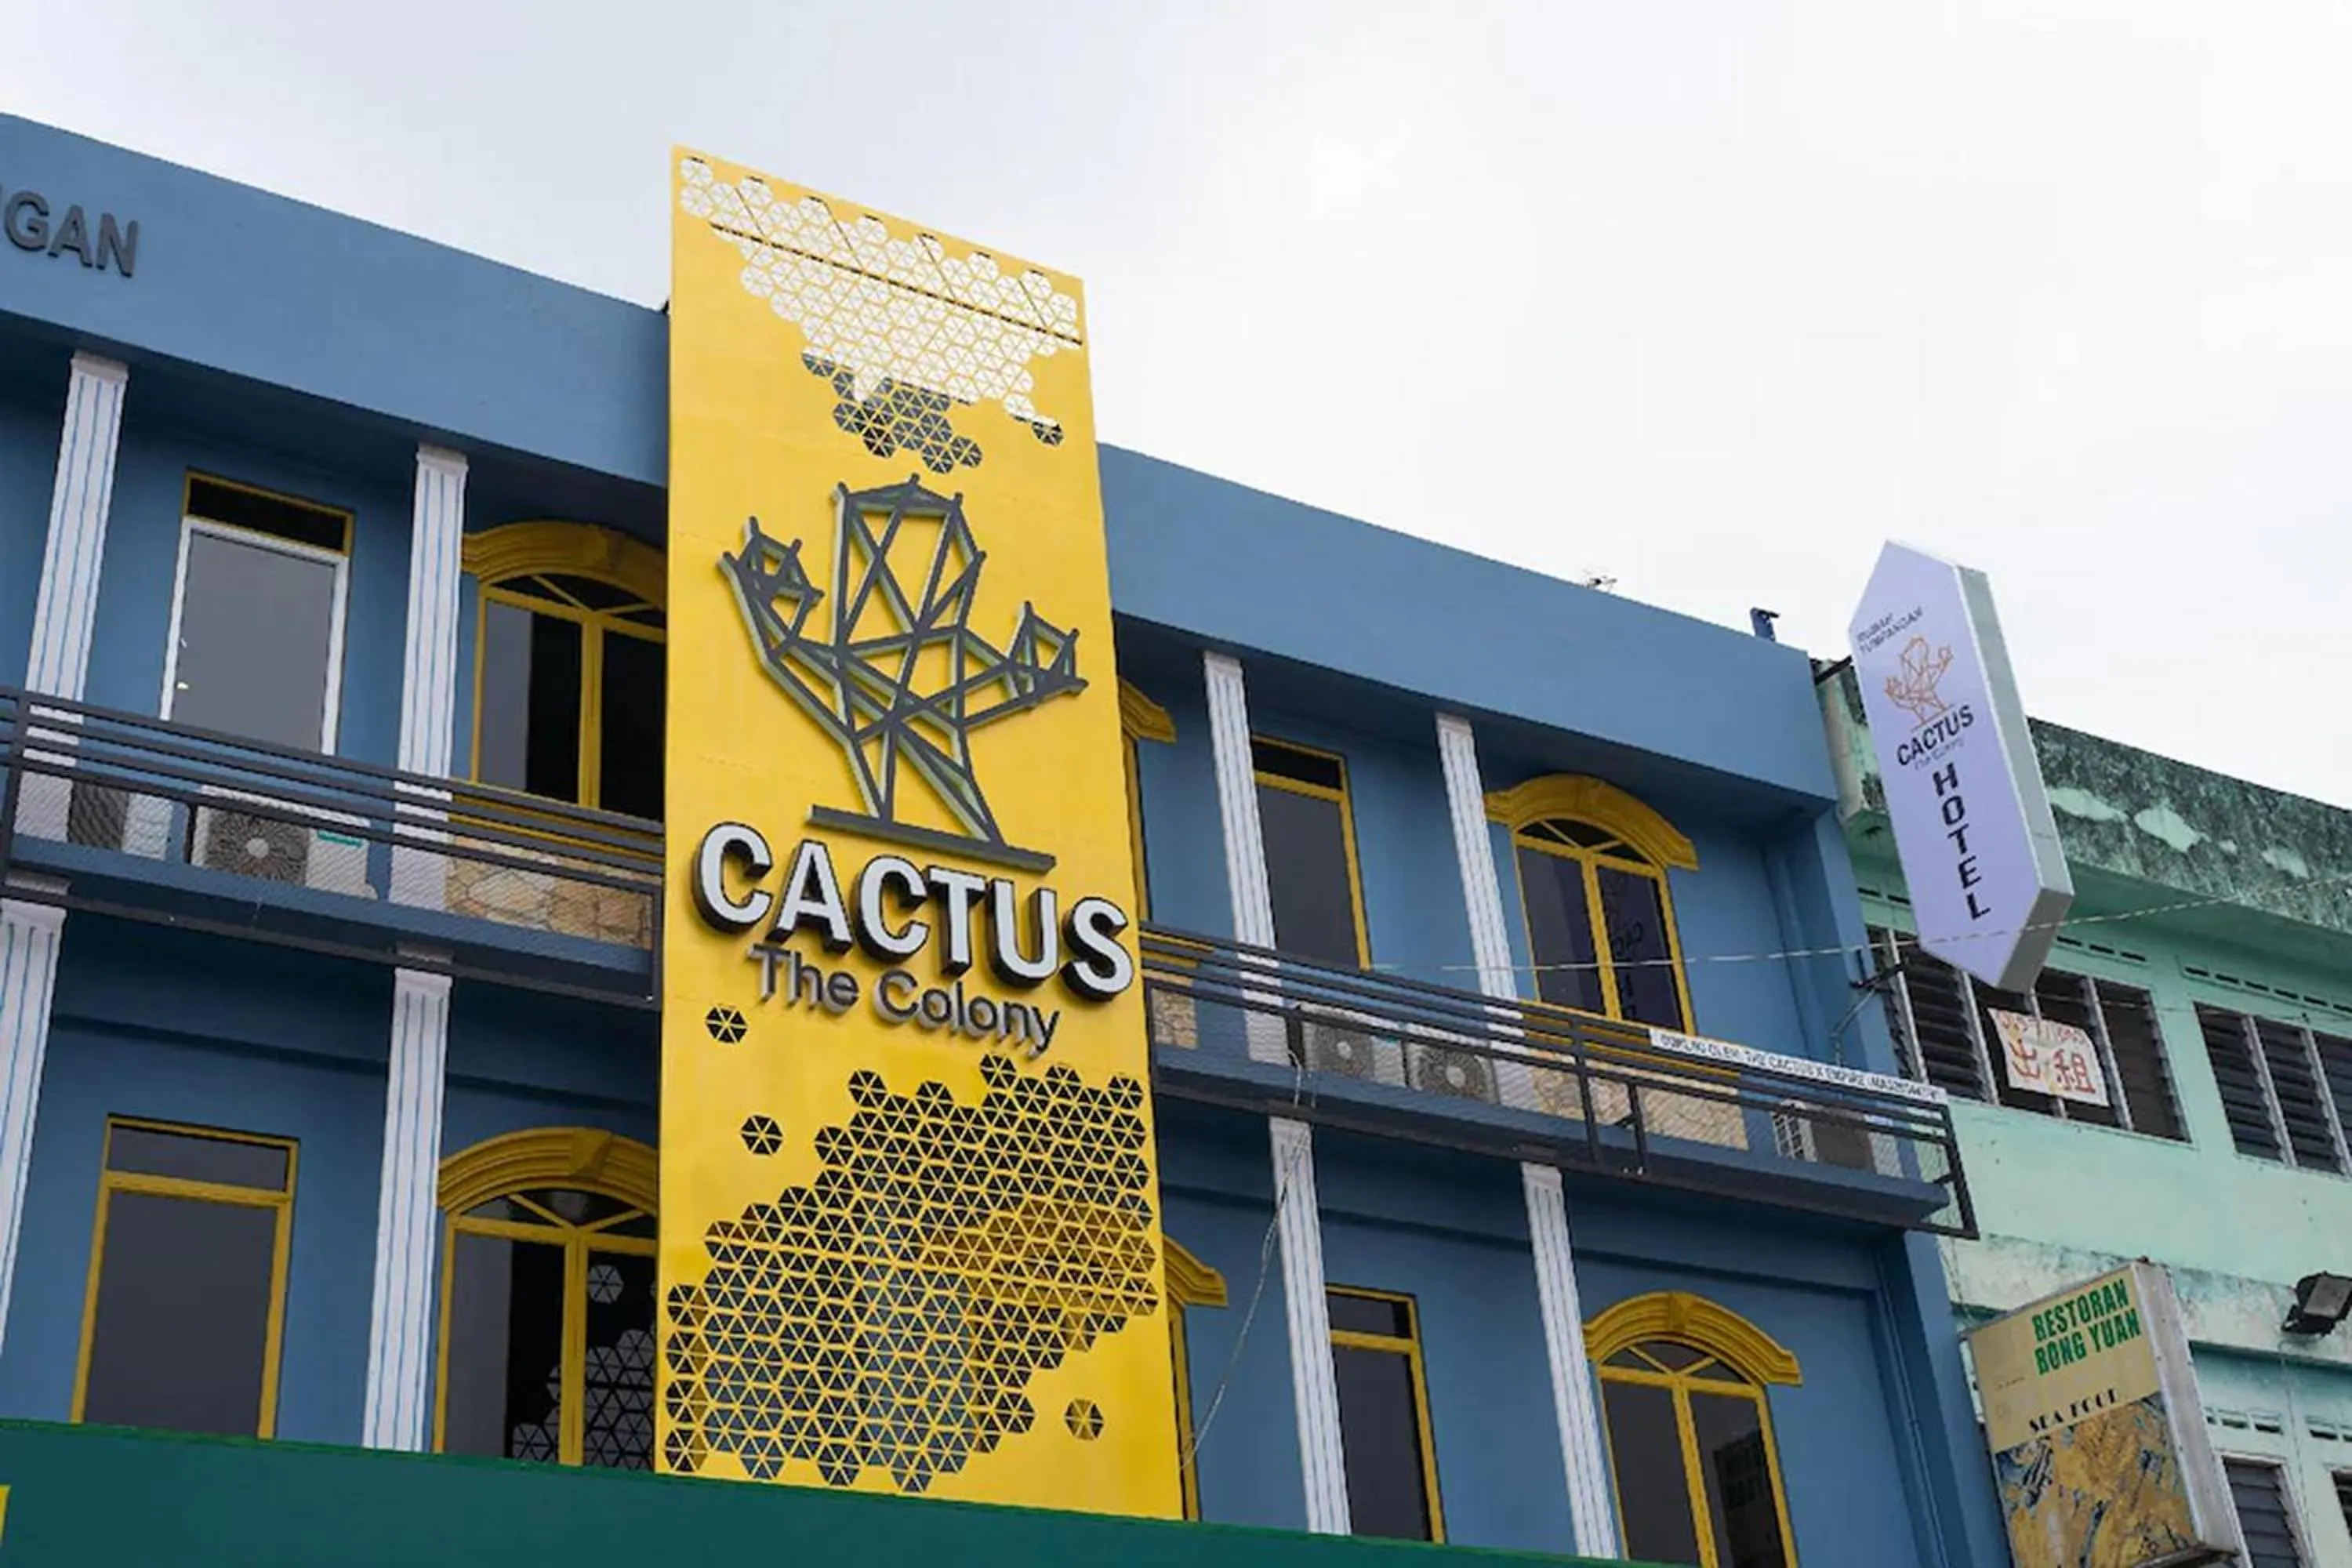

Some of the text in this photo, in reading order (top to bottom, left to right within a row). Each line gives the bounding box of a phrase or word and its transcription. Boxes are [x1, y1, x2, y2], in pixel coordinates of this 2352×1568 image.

[0, 182, 139, 278] GAN
[1897, 705, 1974, 765] CACTUS
[1933, 762, 1991, 920] HOTEL
[693, 821, 1134, 1002] CACTUS
[747, 942, 1060, 1060] The Colony
[2008, 1039, 2096, 1094] 出租
[2032, 1278, 2129, 1342] RESTORAN
[2034, 1308, 2141, 1375] RONG YUAN
